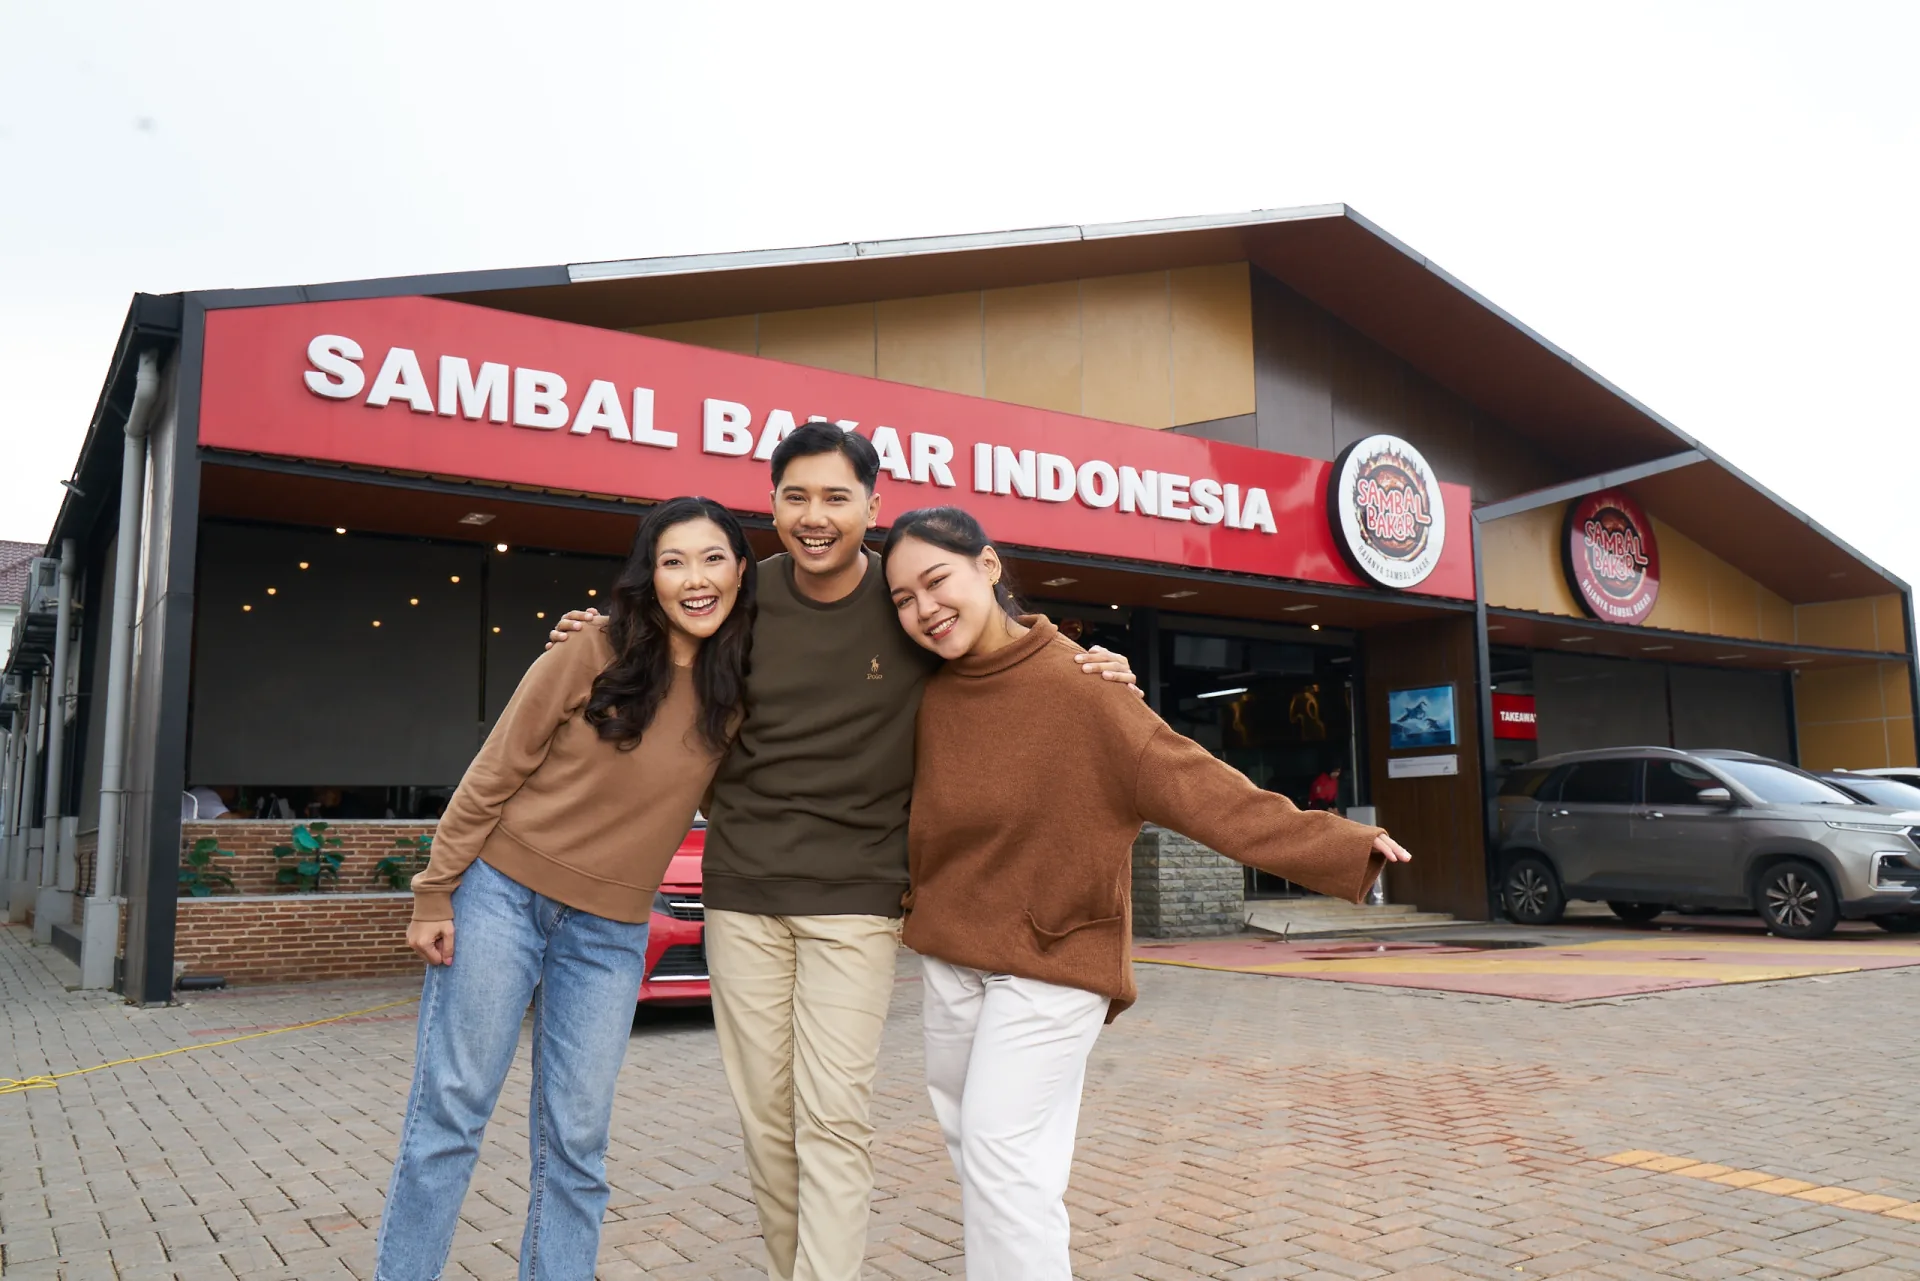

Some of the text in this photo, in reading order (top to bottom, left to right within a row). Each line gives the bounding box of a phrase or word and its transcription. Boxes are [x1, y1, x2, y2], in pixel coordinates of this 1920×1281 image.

[303, 333, 678, 449] SAMBAL
[974, 442, 1278, 534] INDONESIA
[1357, 479, 1431, 524] SAMBAL
[1367, 506, 1416, 541] BAKAR
[1585, 520, 1648, 565] SAMBAL
[1357, 545, 1431, 580] RAJANYA SAMBAL BAKAR
[1593, 547, 1636, 581] BAKAR
[1582, 578, 1652, 618] RAJANYA SAMBAL BAKAR
[1500, 711, 1537, 723] TAKEAWA
